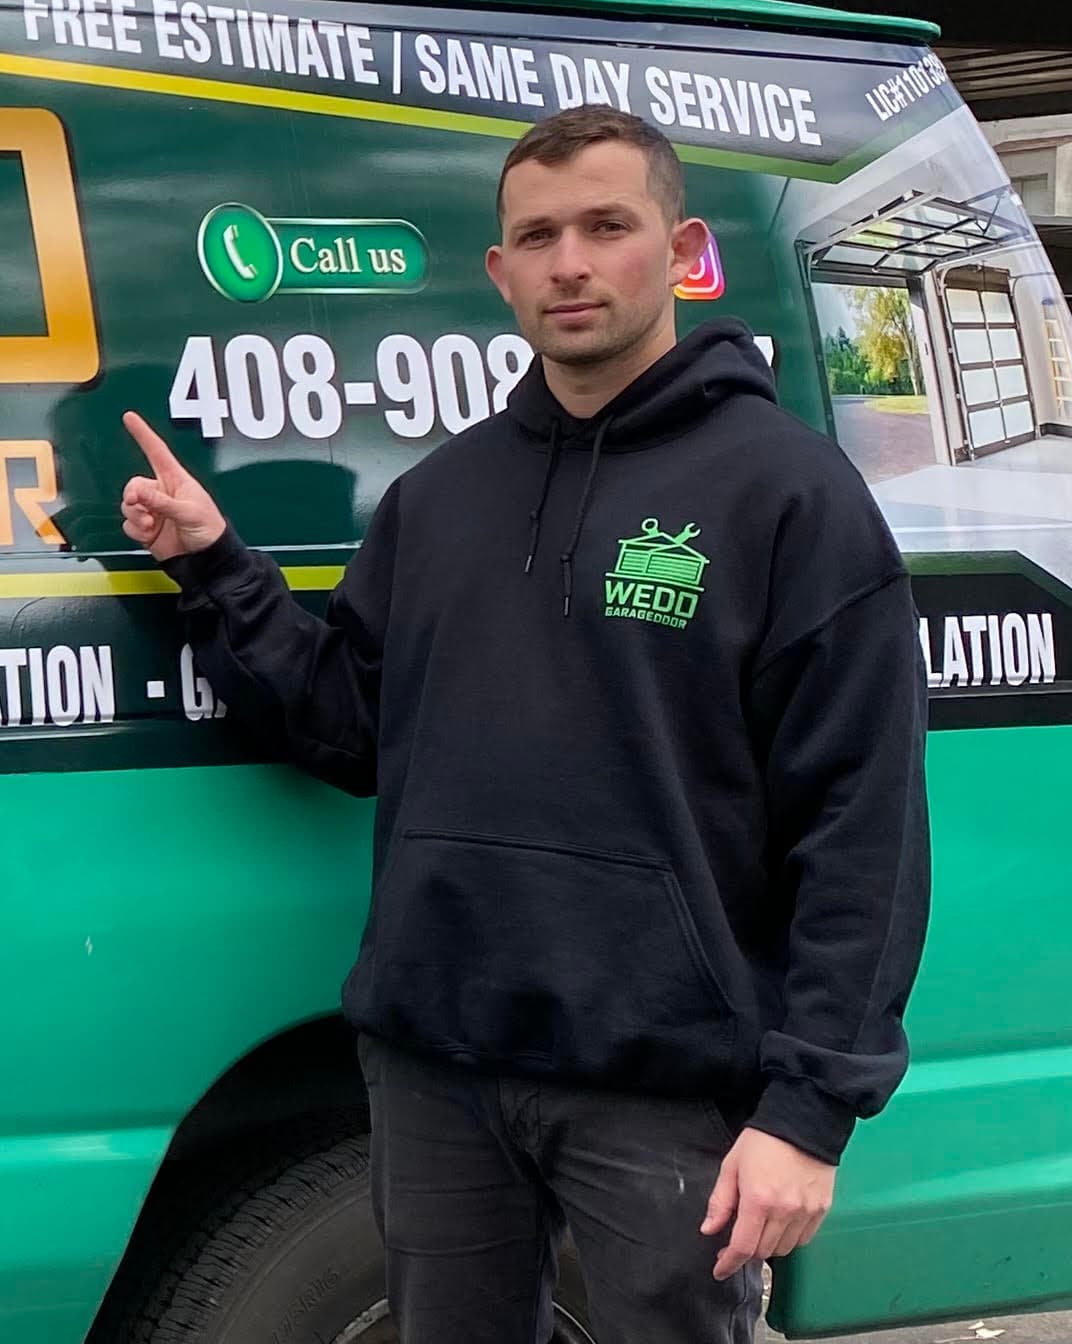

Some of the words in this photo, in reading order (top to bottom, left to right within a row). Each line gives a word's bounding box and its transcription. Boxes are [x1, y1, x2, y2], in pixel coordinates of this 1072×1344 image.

[415, 33, 546, 109] SAME
[548, 52, 630, 114] DAY
[646, 65, 822, 146] SERVICE
[291, 238, 362, 273] Call
[369, 247, 407, 273] us
[168, 333, 535, 440] 408-908
[604, 606, 688, 630] GARAGEDOOR
[605, 580, 699, 619] WEDO
